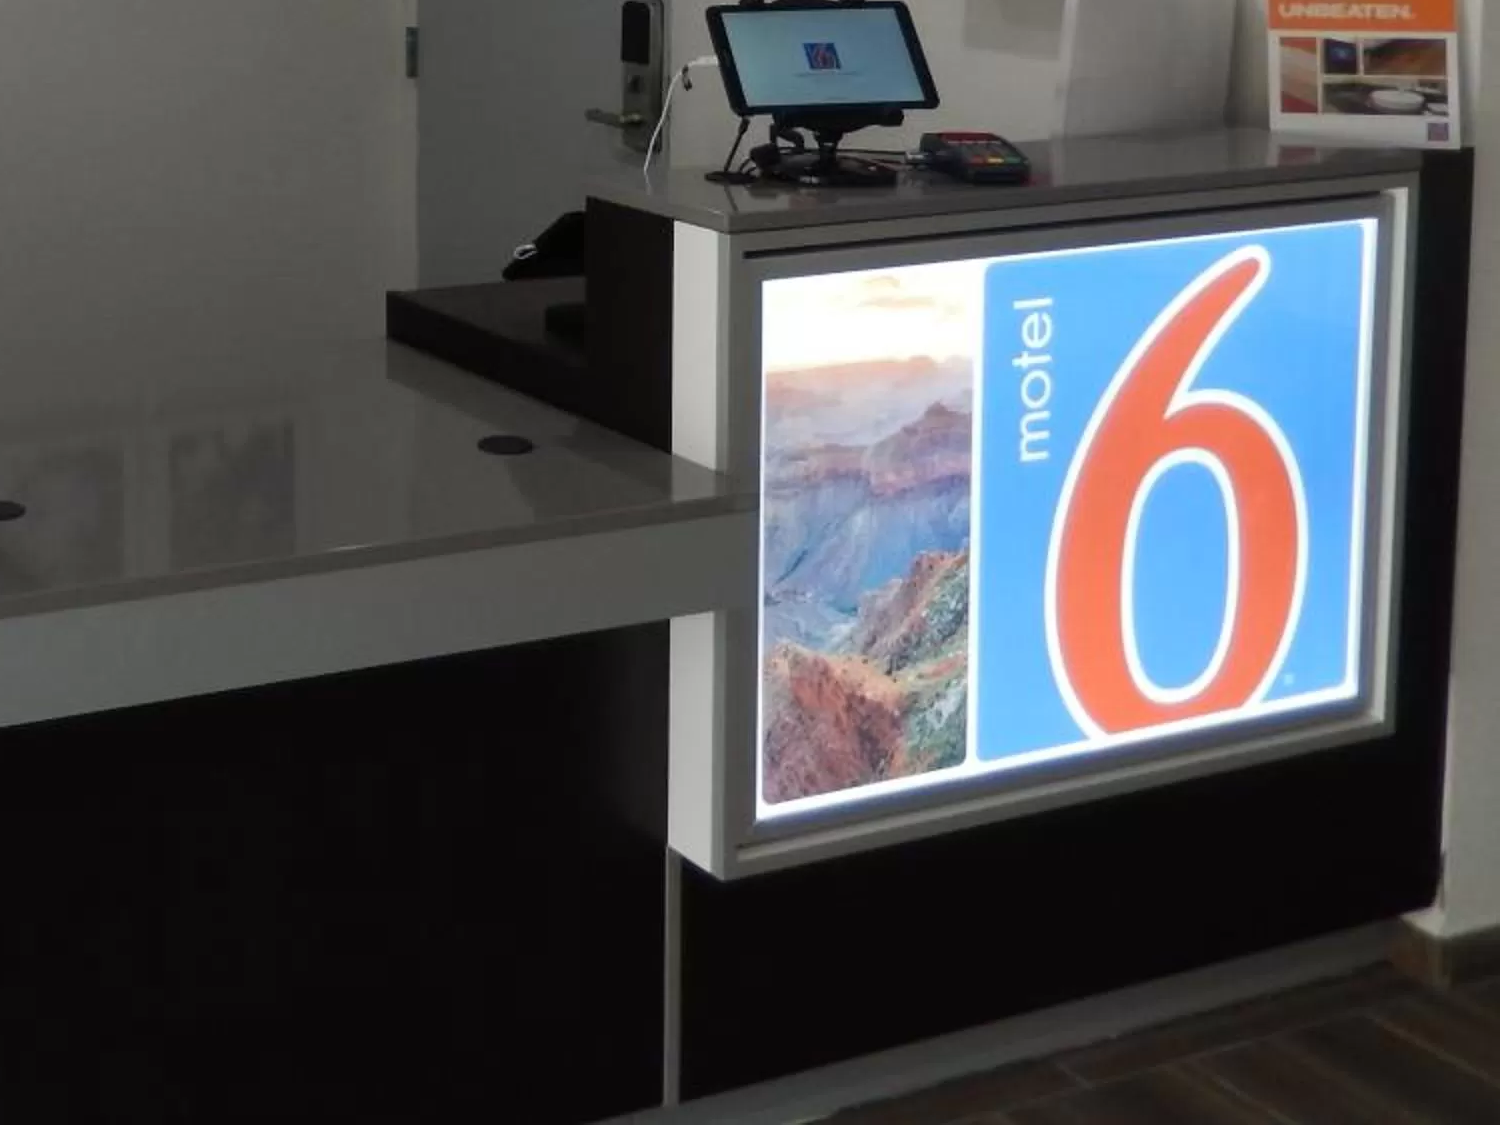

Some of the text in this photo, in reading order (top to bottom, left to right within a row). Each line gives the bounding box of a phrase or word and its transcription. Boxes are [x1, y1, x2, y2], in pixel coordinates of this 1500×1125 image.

[1277, 2, 1417, 21] UNBEATEN.
[1012, 295, 1056, 463] motel
[1044, 243, 1308, 742] 6
